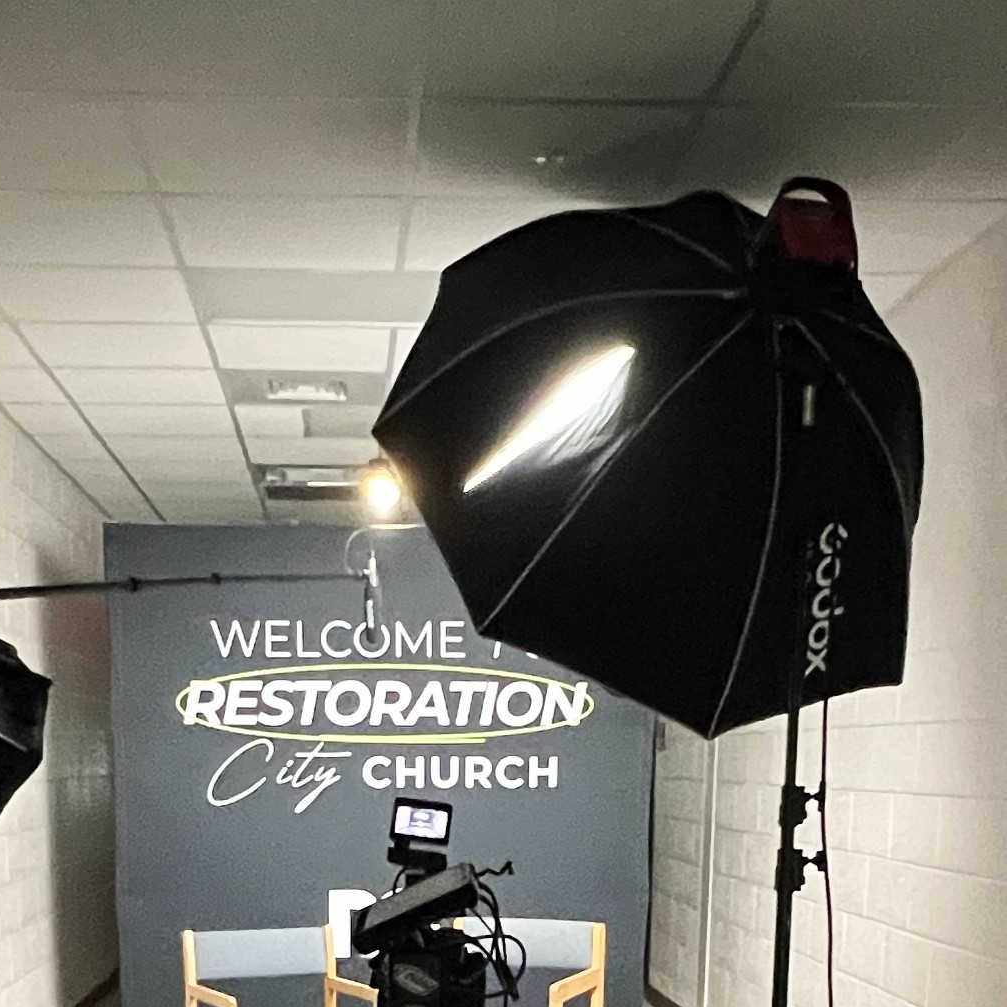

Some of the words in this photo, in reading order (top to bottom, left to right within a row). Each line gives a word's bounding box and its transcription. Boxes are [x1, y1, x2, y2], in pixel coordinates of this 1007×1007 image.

[209, 619, 467, 660] WELCOME
[183, 680, 589, 727] RESTORATION
[207, 738, 353, 814] City
[362, 755, 559, 790] CHURCH
